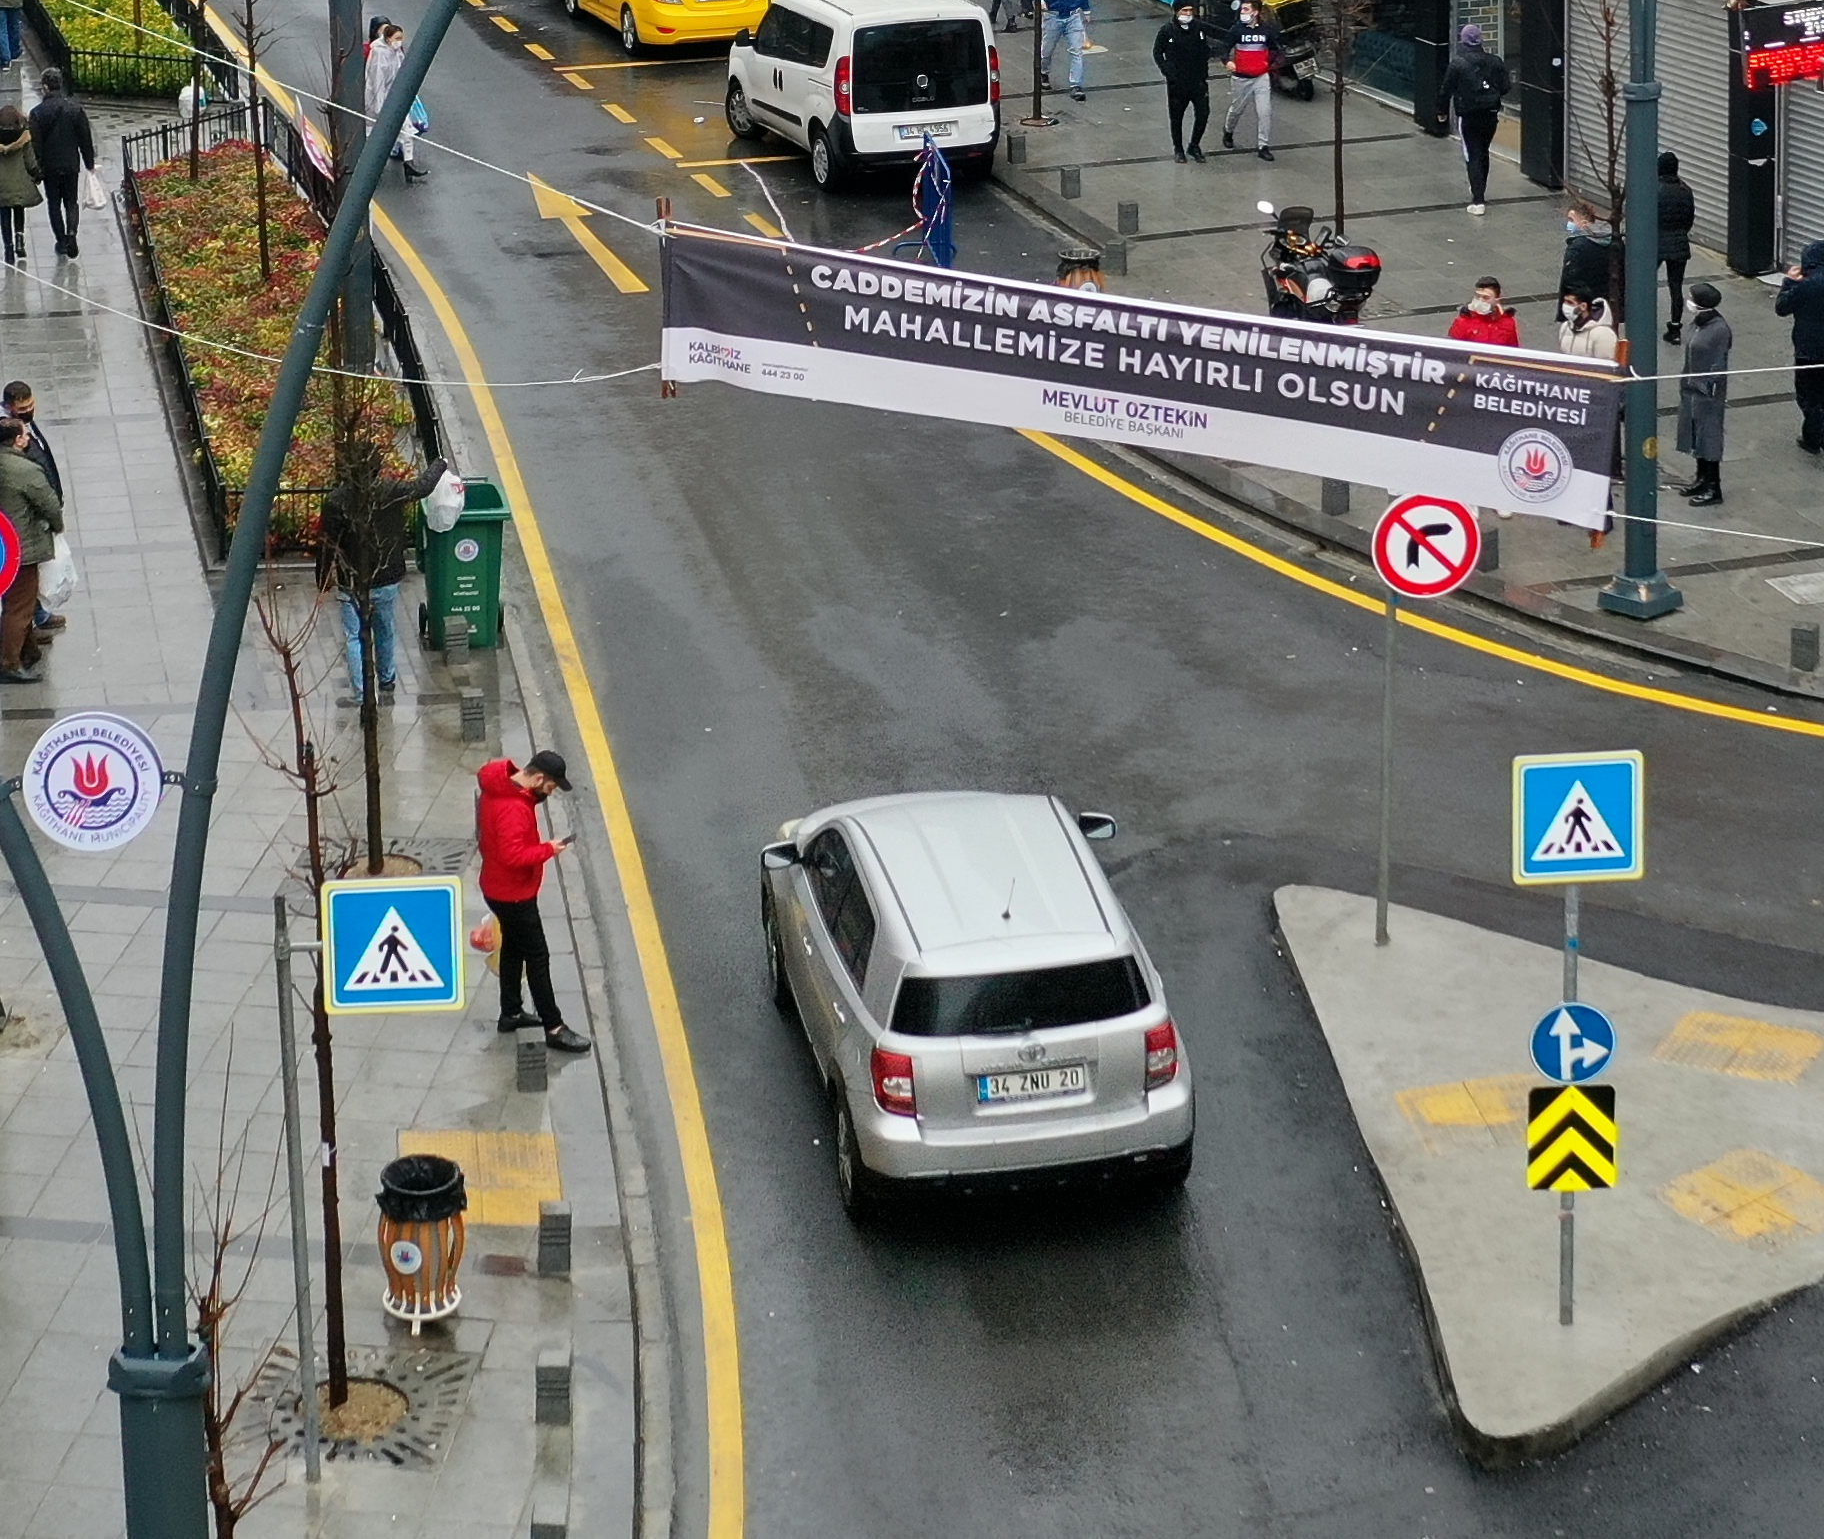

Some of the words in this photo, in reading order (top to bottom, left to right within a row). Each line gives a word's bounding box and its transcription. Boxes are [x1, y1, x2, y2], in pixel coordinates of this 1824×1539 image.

[1241, 33, 1266, 43] ICON
[811, 264, 1020, 319] CADDEMİZİN
[1027, 299, 1168, 342] ASFALTI
[1179, 318, 1447, 387] YENİLENMİŞTİR
[689, 351, 751, 375] KÂĞITHANE
[761, 368, 777, 378] 444
[780, 370, 792, 380] 23
[794, 372, 805, 381] 00
[844, 304, 1105, 370] MAHALLEMİZE
[1119, 347, 1263, 393] HAYIRLI
[1277, 372, 1405, 416] OLSUN
[1476, 372, 1591, 404] KÂĞITHANE
[1064, 411, 1125, 431] BELEDİYE
[1128, 420, 1184, 439] BAŞKANI
[1474, 393, 1587, 426] BELEDİYESİ
[32, 728, 87, 775] KÂĞITHANE
[93, 728, 151, 773] BELEDİYESİ
[32, 794, 85, 843] KÂĞITHANE
[91, 789, 152, 843] MUNICIPALITY
[991, 1078, 1009, 1095] 34
[1020, 1073, 1050, 1092] ZNU
[1060, 1069, 1079, 1087] 20
